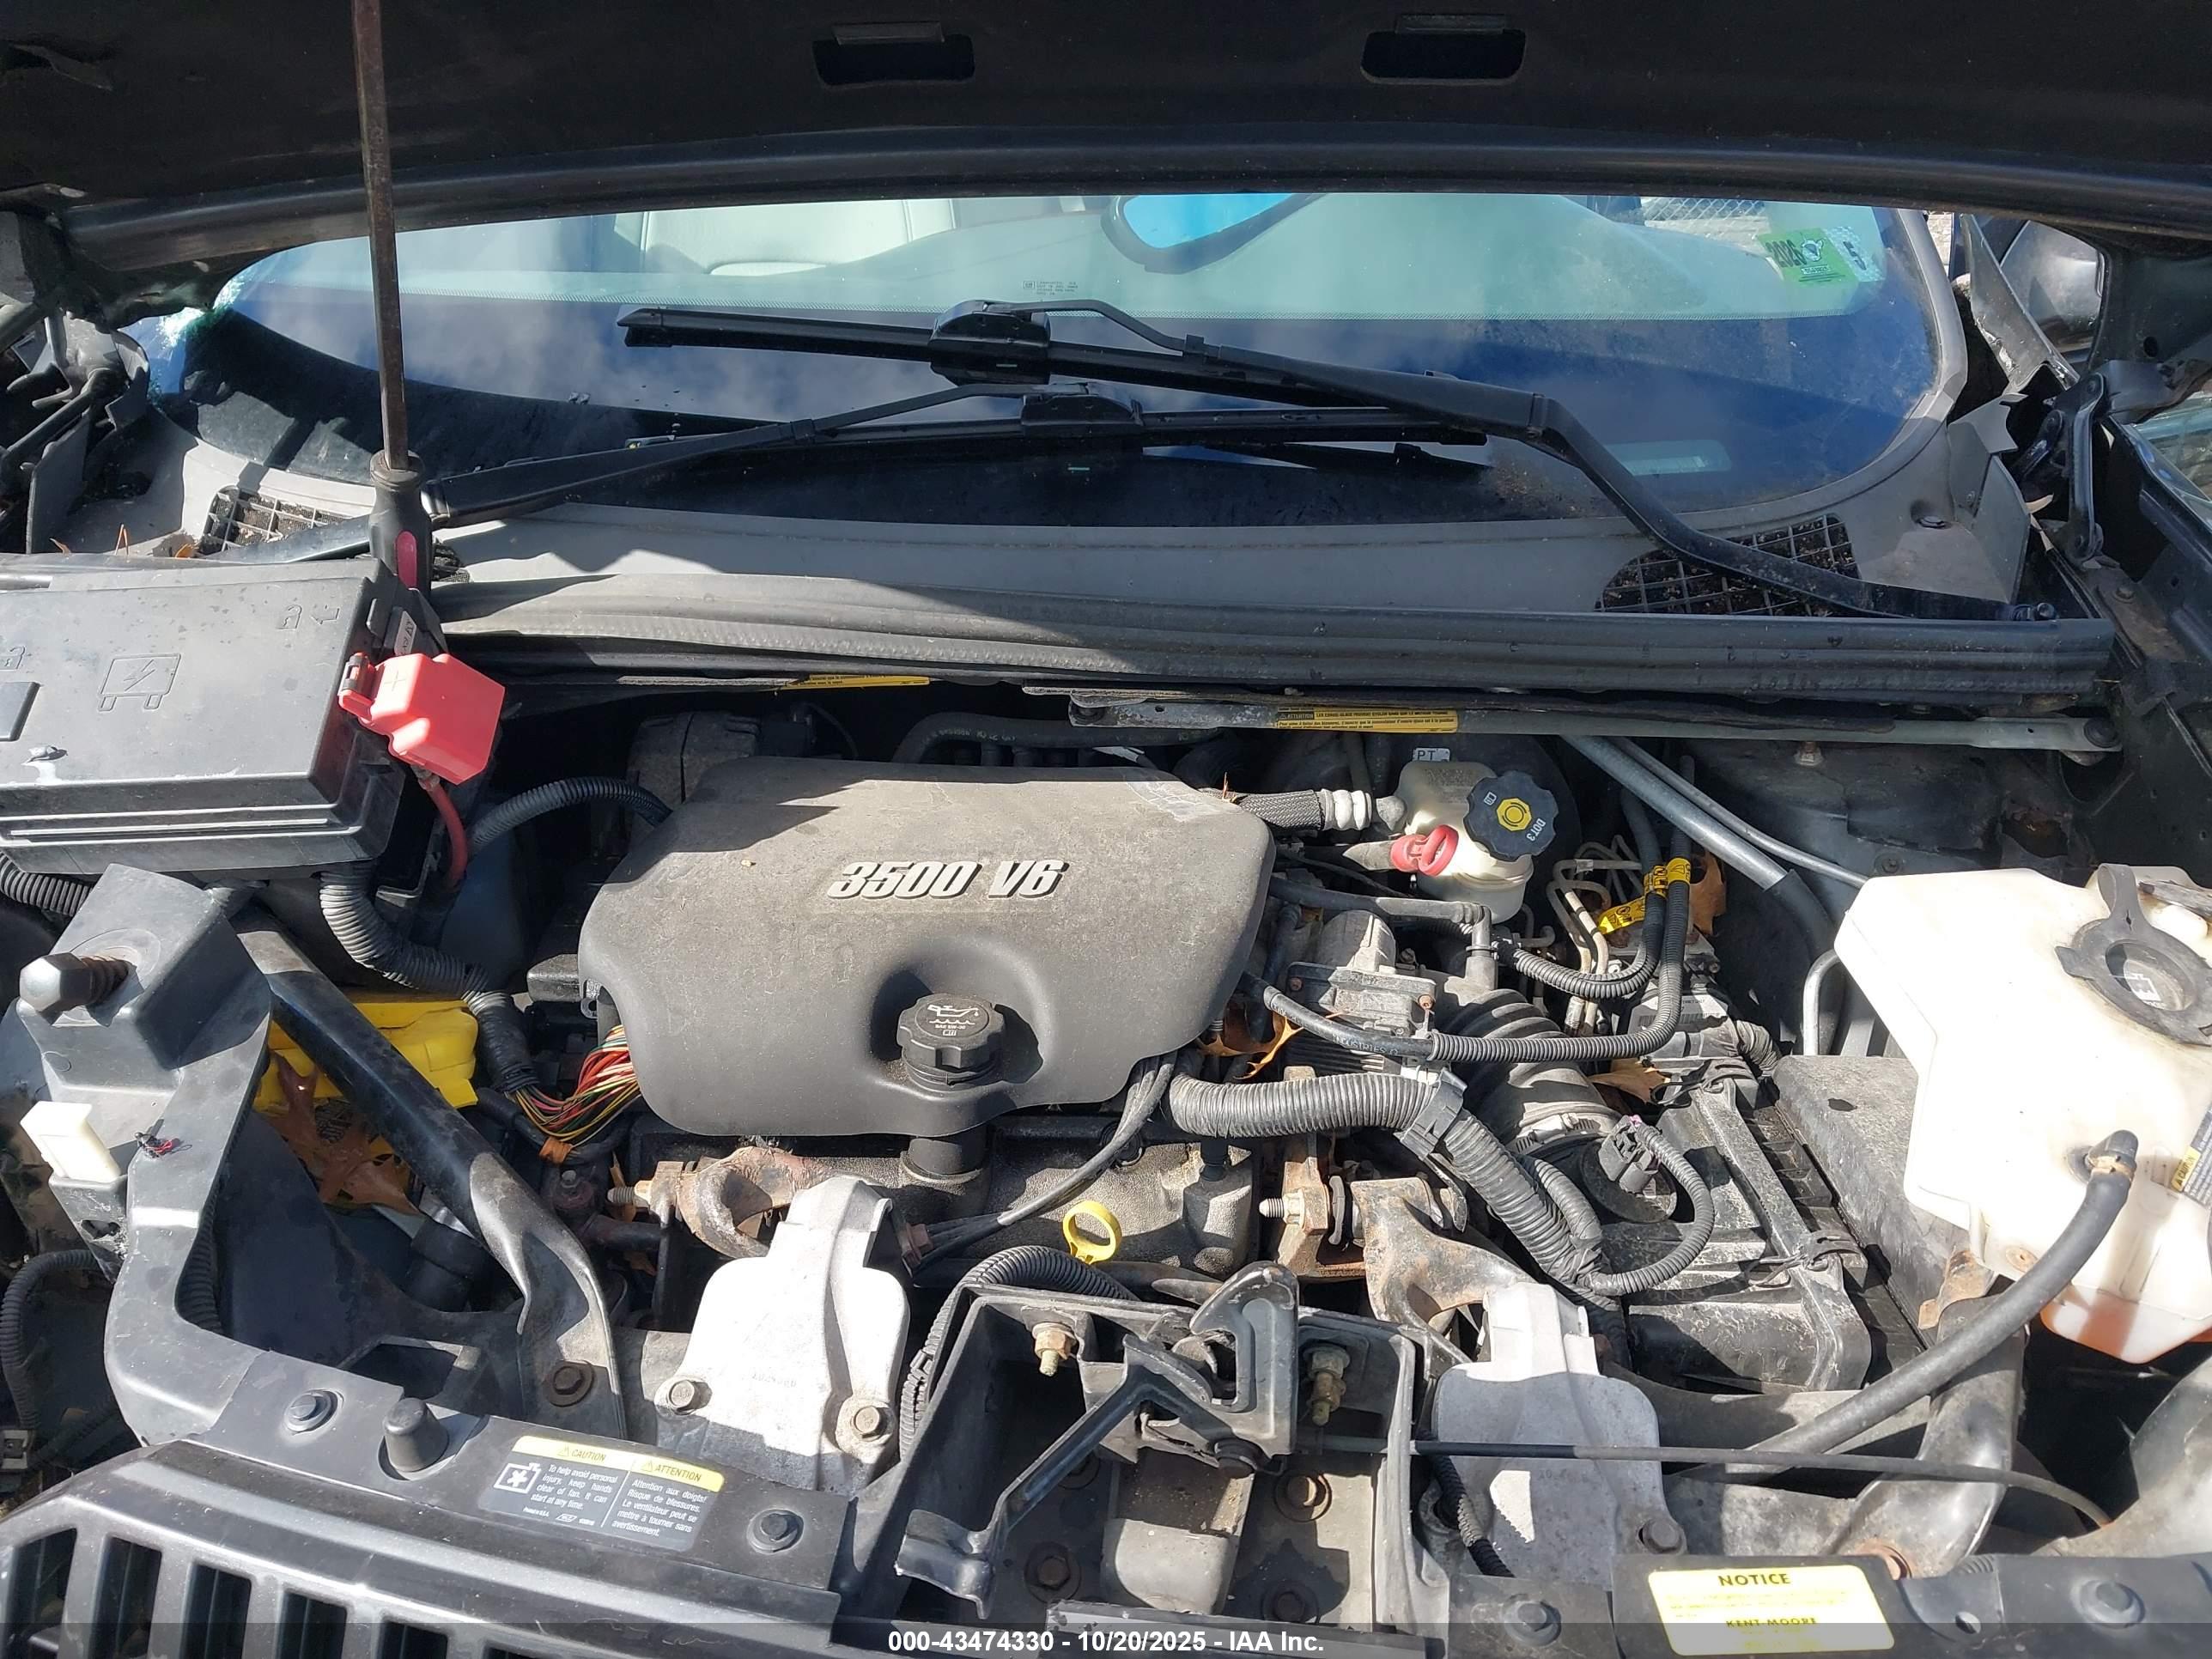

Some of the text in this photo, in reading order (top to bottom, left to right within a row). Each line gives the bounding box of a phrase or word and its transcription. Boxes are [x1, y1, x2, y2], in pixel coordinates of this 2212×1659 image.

[1765, 240, 1808, 268] 2026
[827, 860, 1070, 900] 3500 V6
[1333, 1034, 1386, 1054] INDUSTRIES
[571, 1449, 607, 1462] CAUTION
[549, 1464, 618, 1483] To help avoid personal
[654, 1464, 702, 1482] ATTENTION
[536, 1484, 555, 1492] clear
[568, 1479, 586, 1489] keep
[591, 1483, 612, 1493] hands
[627, 1489, 651, 1500] Risque
[632, 1479, 664, 1492] Attention
[665, 1487, 680, 1496] aux
[531, 1493, 547, 1503] start
[554, 1498, 568, 1508] any
[622, 1498, 632, 1508] Le
[633, 1502, 670, 1516] ventilateur
[669, 1510, 687, 1520] peut
[617, 1510, 640, 1521] mettre
[648, 1516, 674, 1528] tourner
[675, 1523, 692, 1533] sans
[1718, 1573, 1790, 1586] NOTICE
